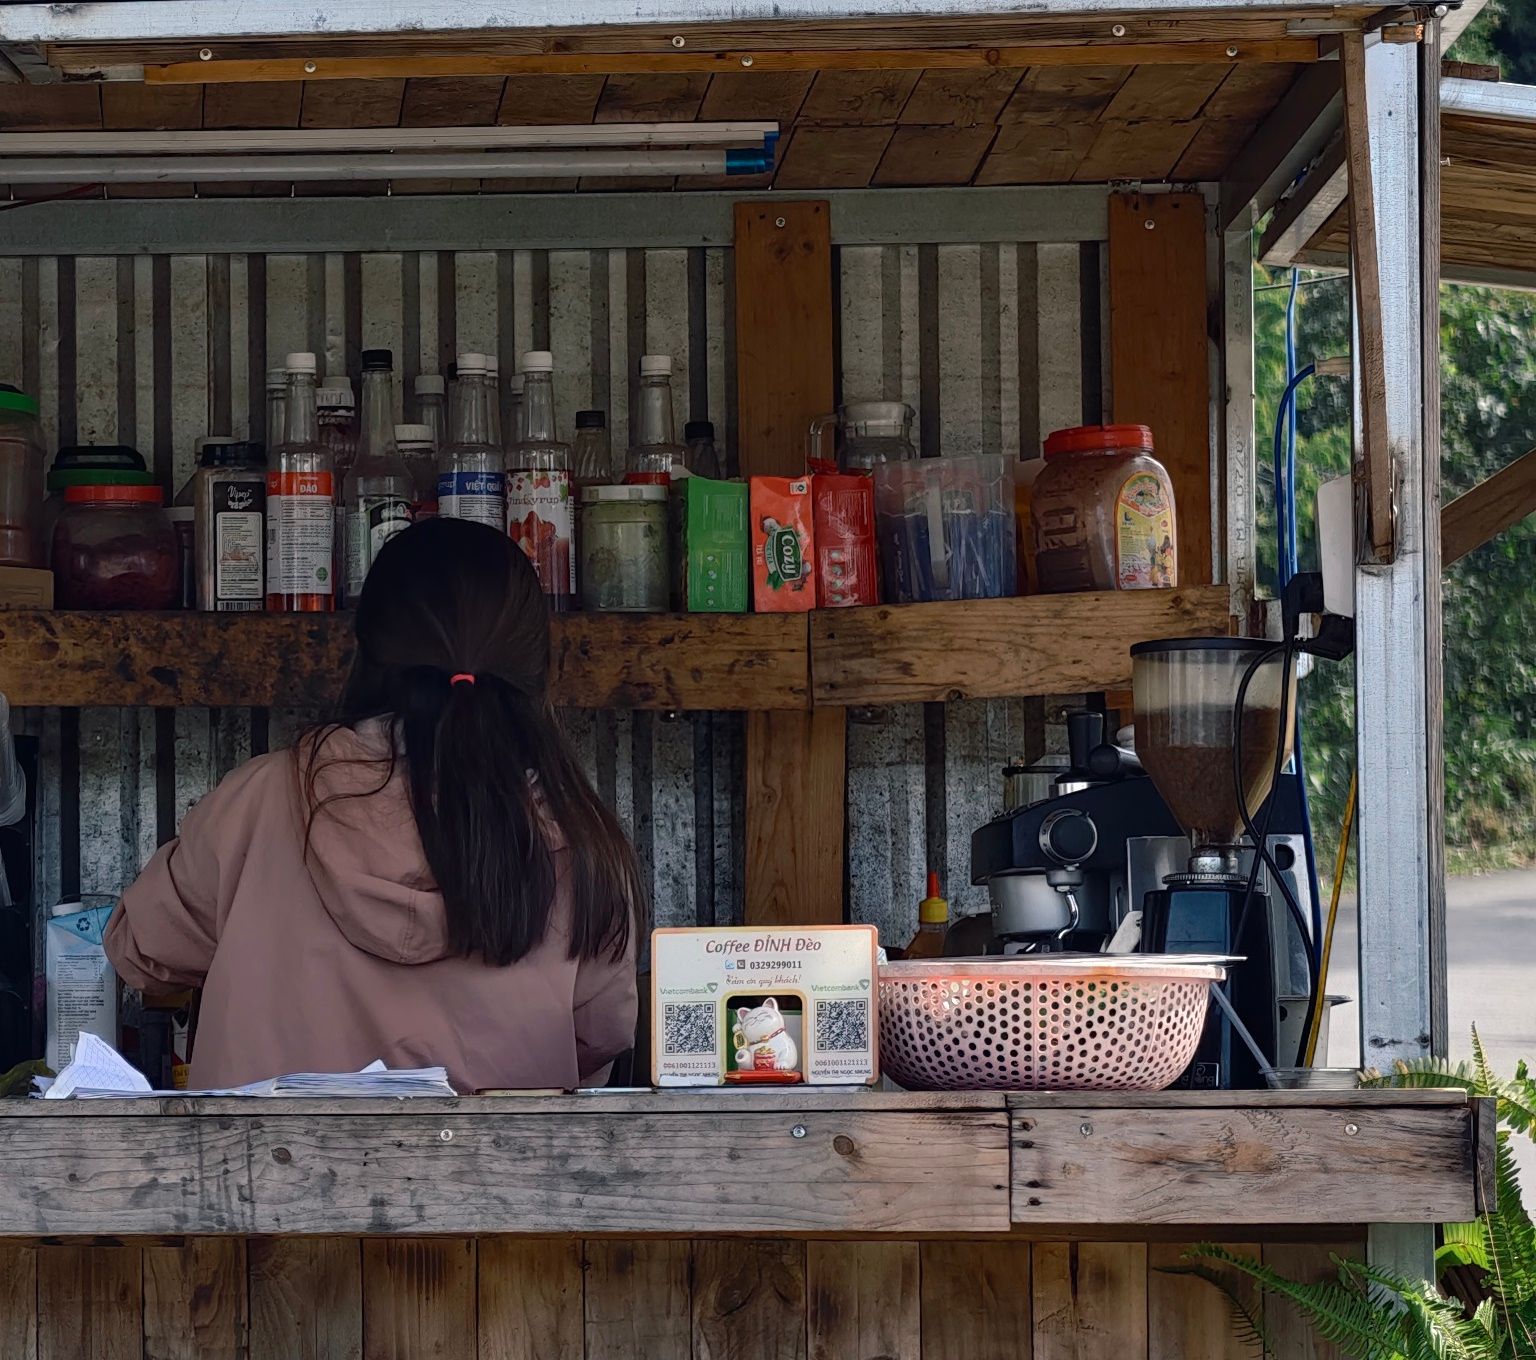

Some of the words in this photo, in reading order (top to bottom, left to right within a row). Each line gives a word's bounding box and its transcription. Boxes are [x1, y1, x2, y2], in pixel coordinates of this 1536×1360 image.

[781, 534, 798, 575] Cozy
[706, 939, 750, 955] Coffee
[754, 935, 792, 953] ĐỈNH
[795, 938, 822, 951] Đèo
[750, 960, 802, 970] 0329299011
[660, 985, 708, 995] Vietcombank
[810, 983, 860, 992] Vietcombank
